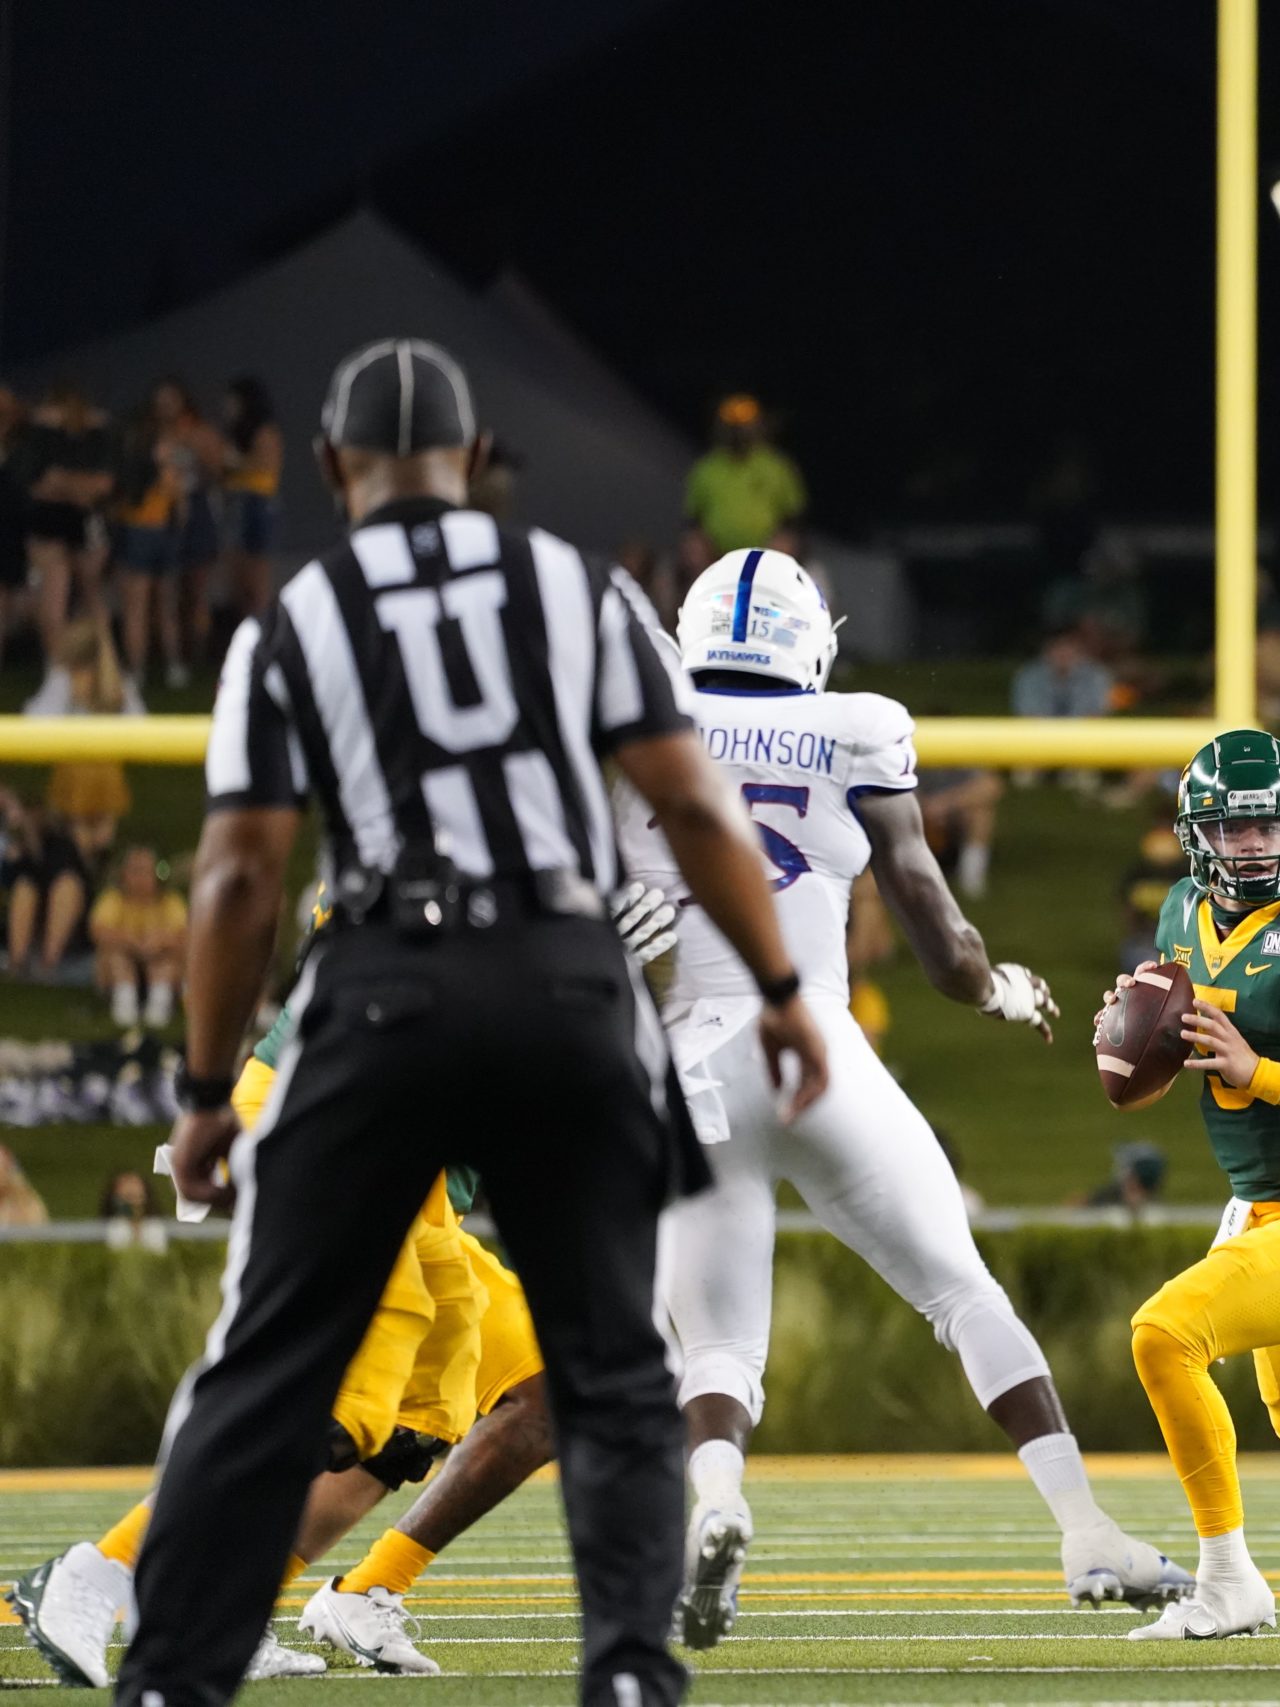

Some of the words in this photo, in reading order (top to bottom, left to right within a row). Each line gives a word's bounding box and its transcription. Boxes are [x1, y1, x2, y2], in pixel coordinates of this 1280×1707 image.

[751, 618, 769, 638] 15
[375, 570, 520, 754] U
[706, 649, 771, 665] JAYHAWKS
